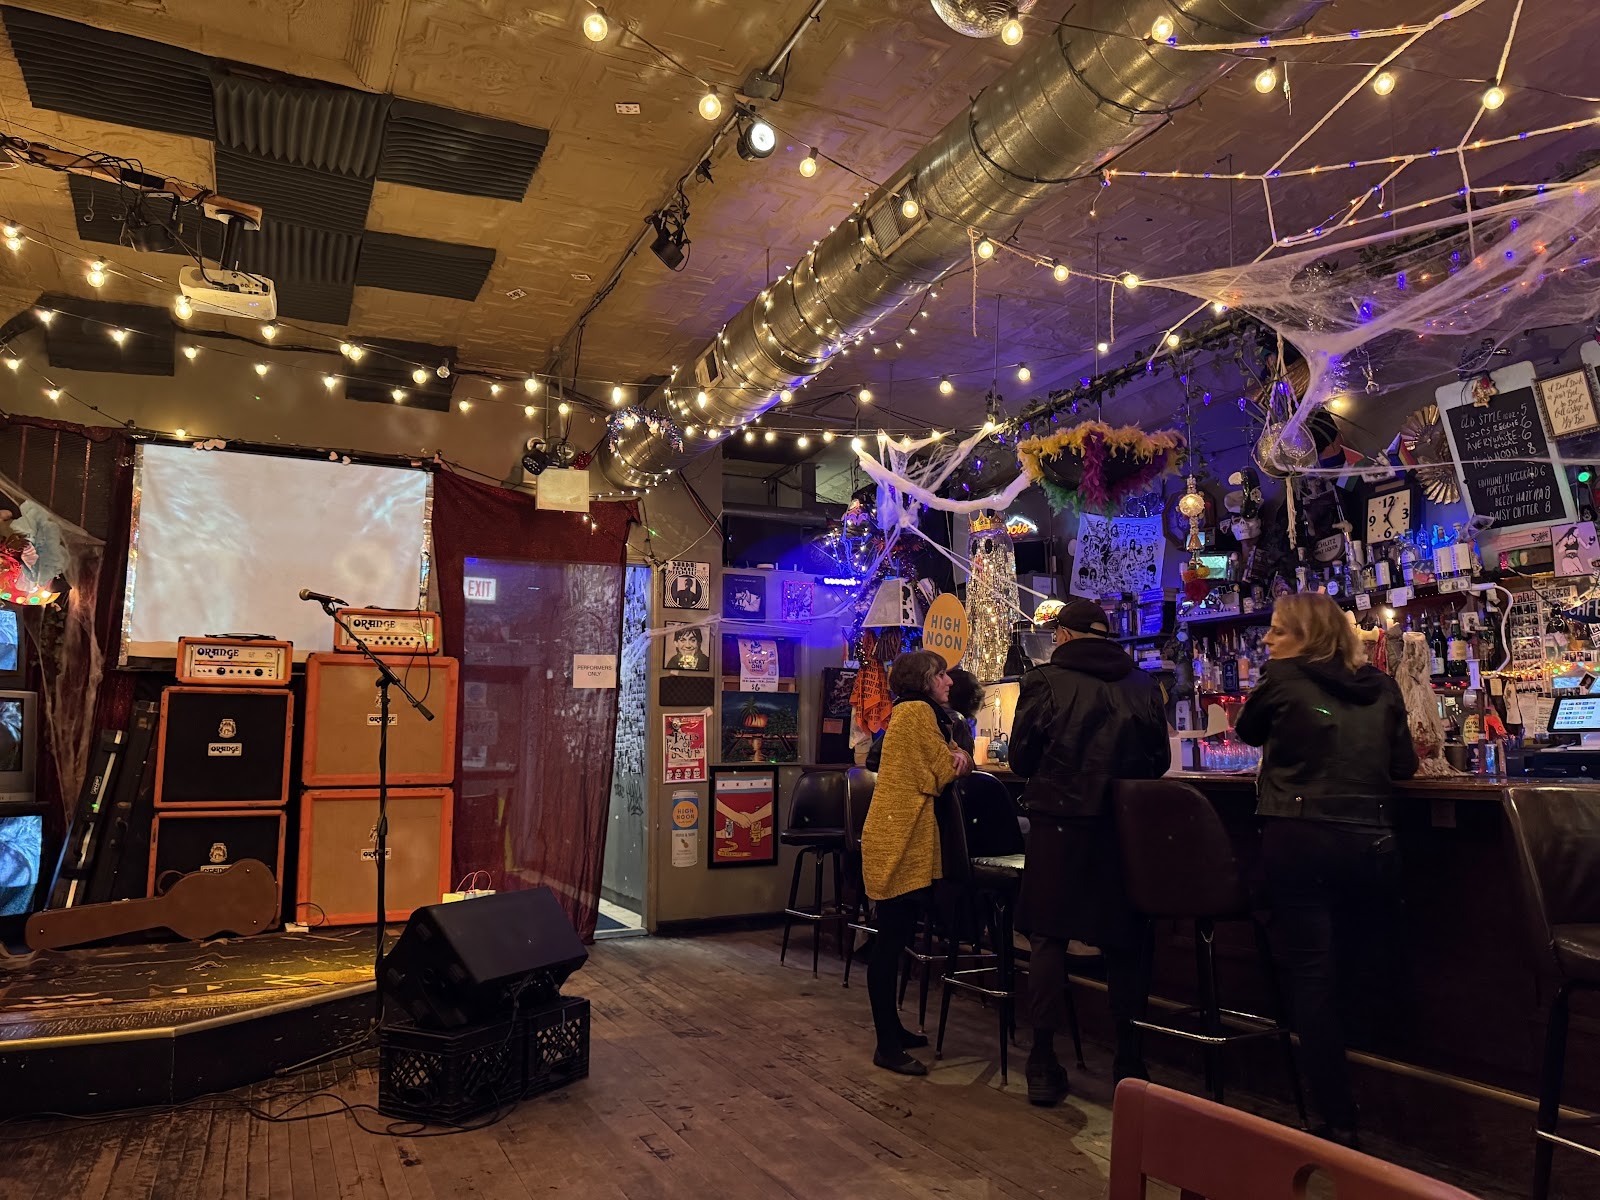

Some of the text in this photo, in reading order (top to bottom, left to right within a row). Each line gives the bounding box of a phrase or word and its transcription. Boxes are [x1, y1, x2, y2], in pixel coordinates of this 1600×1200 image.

[1479, 410, 1502, 426] STYLE
[1520, 402, 1528, 416] 5
[1520, 415, 1532, 429] 6
[1467, 437, 1493, 452] AVERY
[1521, 428, 1532, 440] 6
[1527, 442, 1537, 455] 8
[1540, 464, 1547, 476] 6
[1486, 484, 1510, 497] PORTER
[1516, 490, 1533, 502] HAZY
[1544, 485, 1551, 500] 8
[1382, 496, 1395, 508] 12
[1402, 508, 1409, 520] 3
[1513, 503, 1539, 519] CUTTER
[1544, 501, 1551, 513] 8
[1368, 515, 1376, 527] 9
[1383, 526, 1392, 539] 6
[468, 580, 492, 598] EXIT
[353, 619, 396, 631] ORANGE
[930, 614, 961, 633] HIGH
[925, 631, 963, 651] NOON
[197, 647, 239, 659] ORANGE
[369, 716, 396, 724] ORGE
[210, 745, 240, 754] ORANGE
